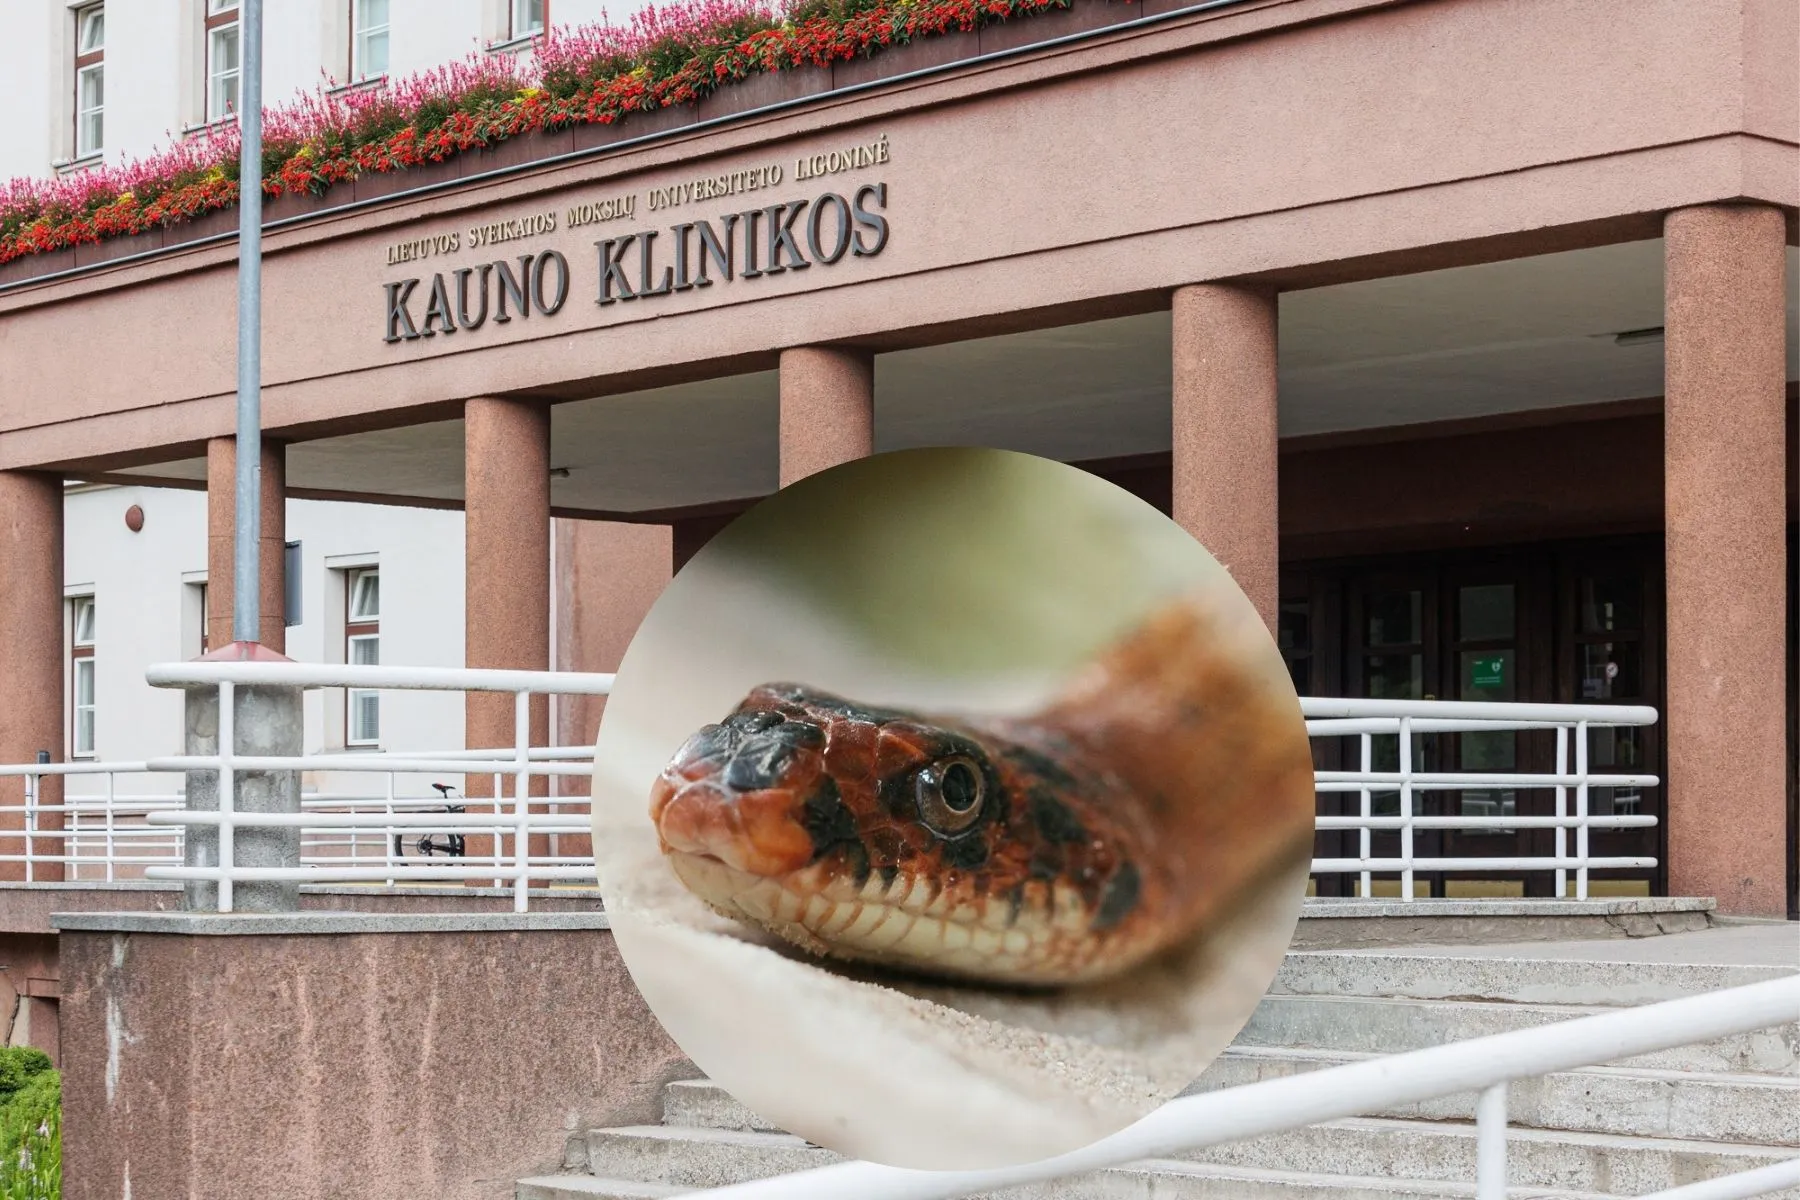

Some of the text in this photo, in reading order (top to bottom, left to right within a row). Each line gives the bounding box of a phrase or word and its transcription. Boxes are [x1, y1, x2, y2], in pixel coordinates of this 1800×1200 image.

[383, 182, 890, 343] KAUNO KLINIKOS
[386, 133, 890, 265] LIETUVOS SVEIKATOS MOKSLŲ UNIVERSITETO LIGONINĖ
